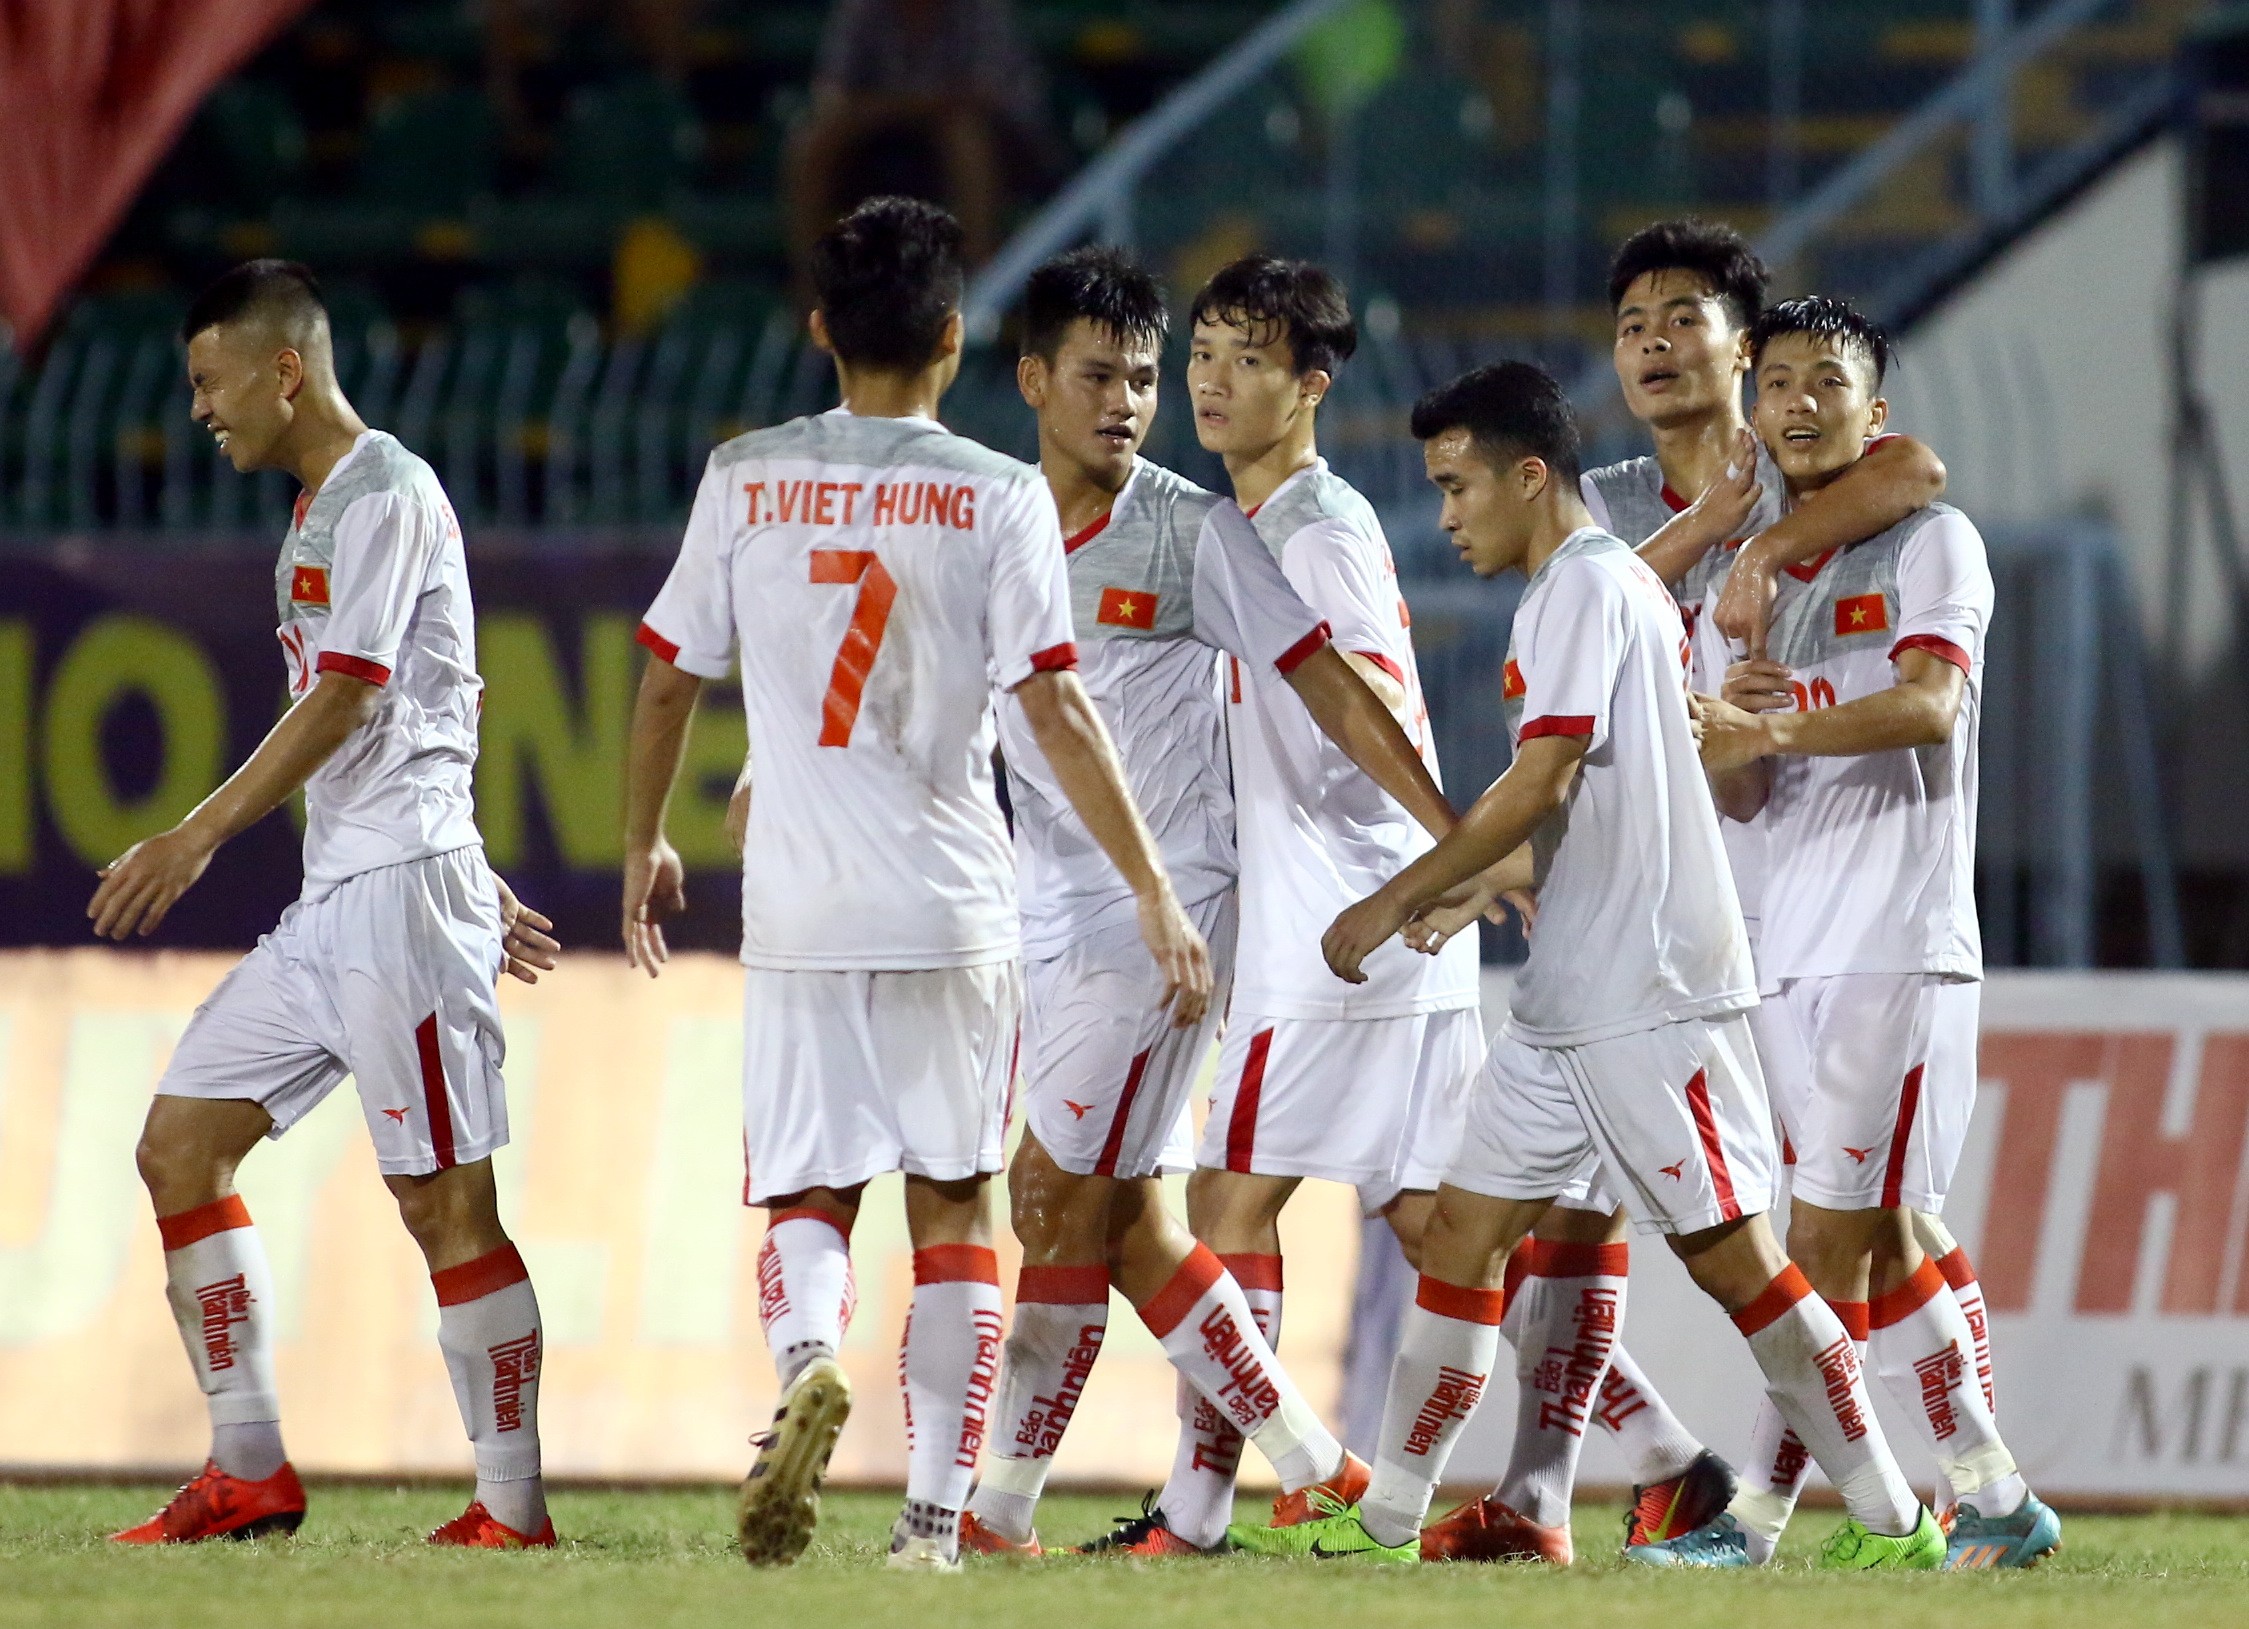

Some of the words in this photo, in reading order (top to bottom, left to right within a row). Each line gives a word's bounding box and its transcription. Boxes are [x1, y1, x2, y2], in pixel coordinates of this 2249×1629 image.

[743, 480, 863, 526] T.VIET
[872, 482, 976, 531] HUNG
[808, 548, 898, 748] 7
[1977, 1030, 2249, 1316] TH
